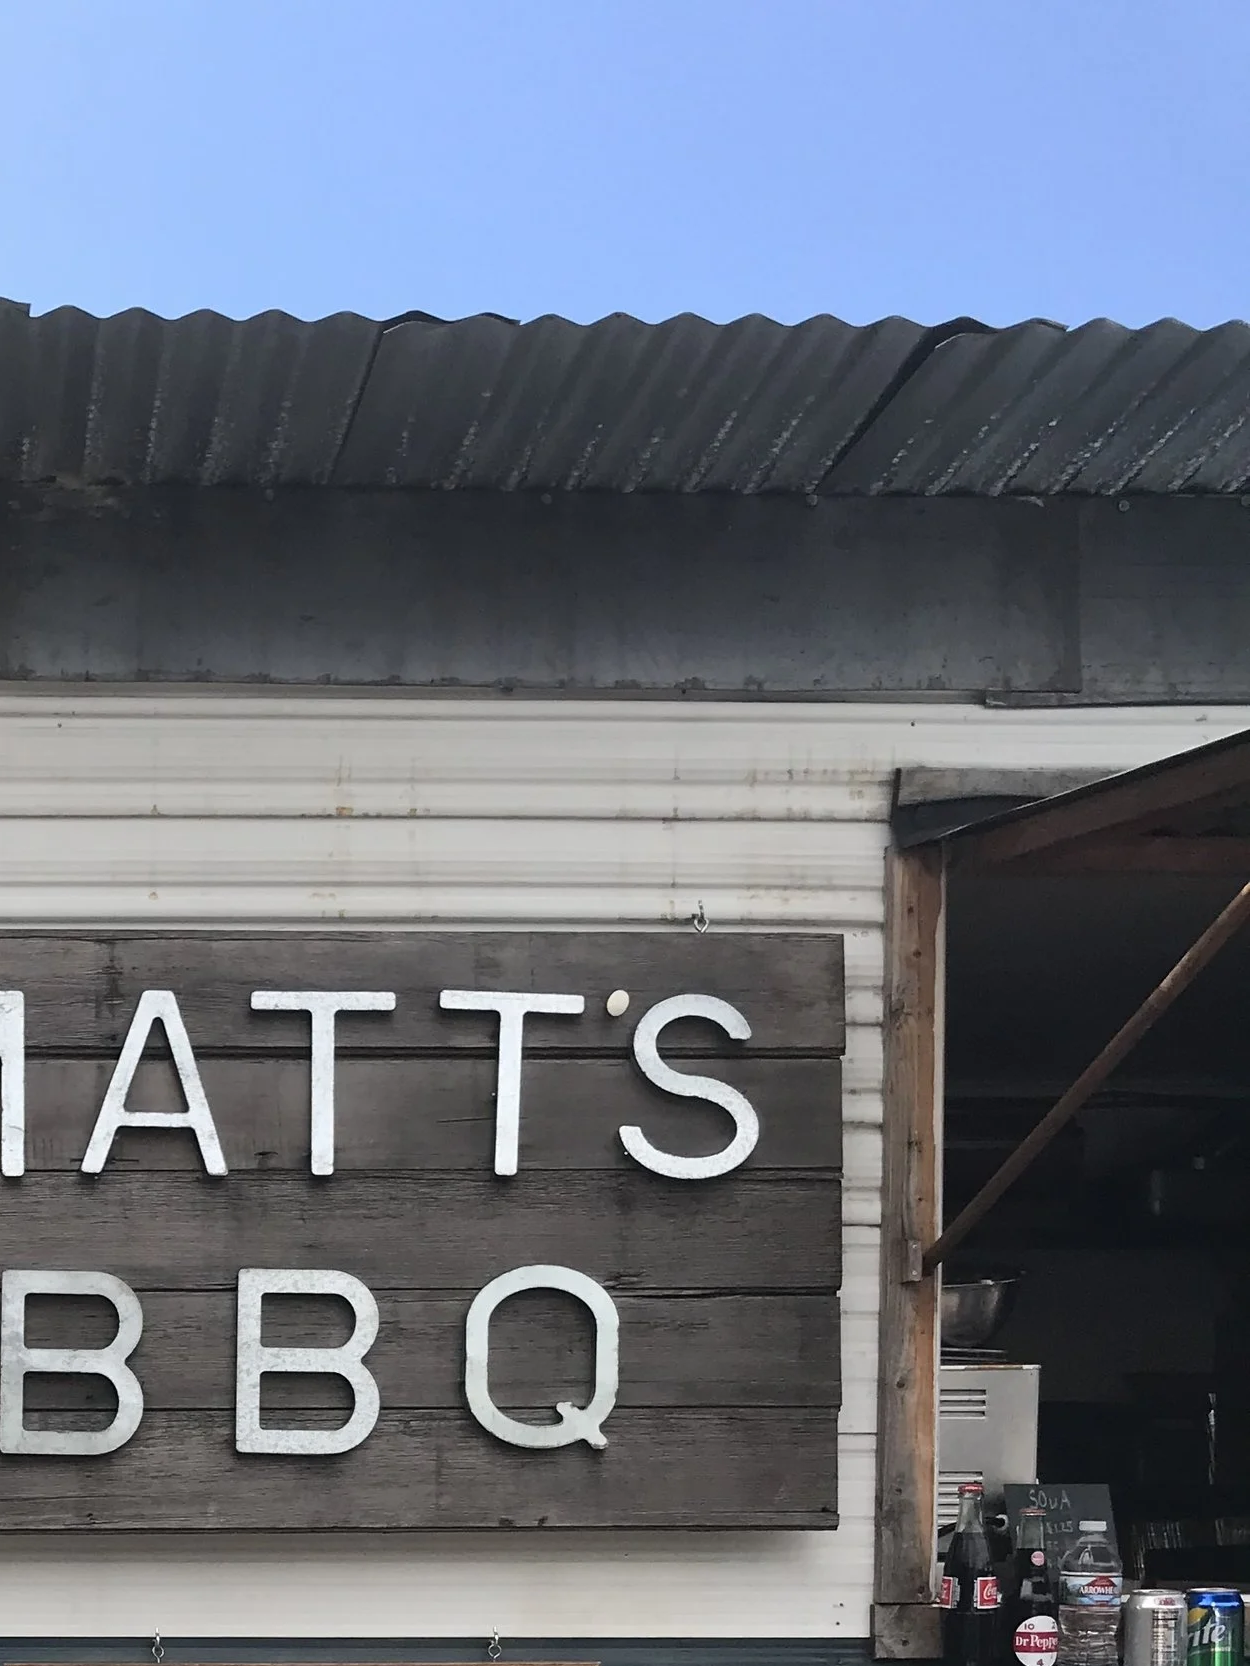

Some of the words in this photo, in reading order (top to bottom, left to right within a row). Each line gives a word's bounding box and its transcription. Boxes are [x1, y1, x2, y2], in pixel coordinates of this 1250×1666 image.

[0, 1264, 621, 1456] BBQ
[1015, 1636, 1029, 1647] Dr
[1036, 1658, 1044, 1666] 4
